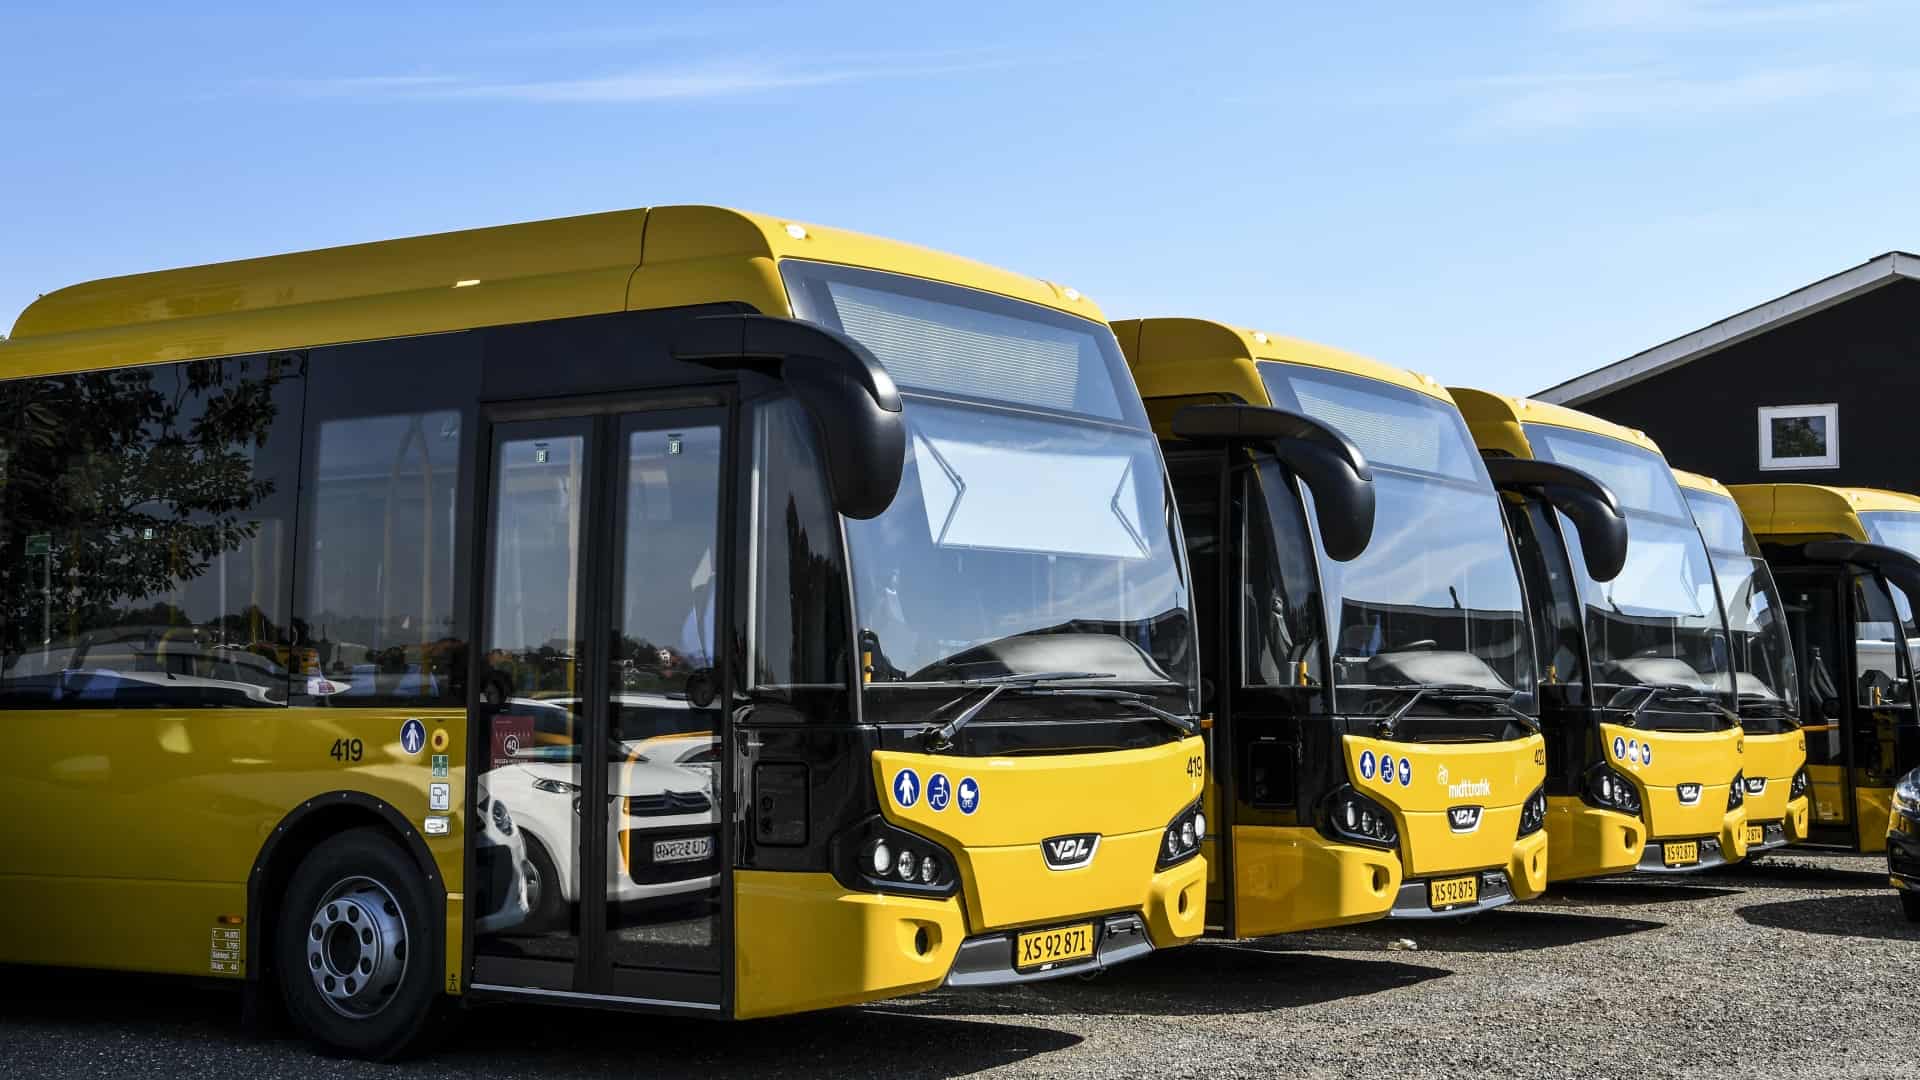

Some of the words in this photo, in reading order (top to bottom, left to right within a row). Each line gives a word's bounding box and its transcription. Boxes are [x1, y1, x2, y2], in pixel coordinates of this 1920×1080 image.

[330, 738, 363, 762] 419
[1186, 755, 1203, 778] 419
[1451, 809, 1476, 825] VDL
[1049, 838, 1089, 860] VDL
[1434, 883, 1446, 902] XS
[1447, 882, 1457, 900] 92
[1458, 880, 1473, 899] 875
[1024, 936, 1042, 961] XS
[1045, 934, 1061, 957] 92
[1064, 930, 1086, 954] 871
